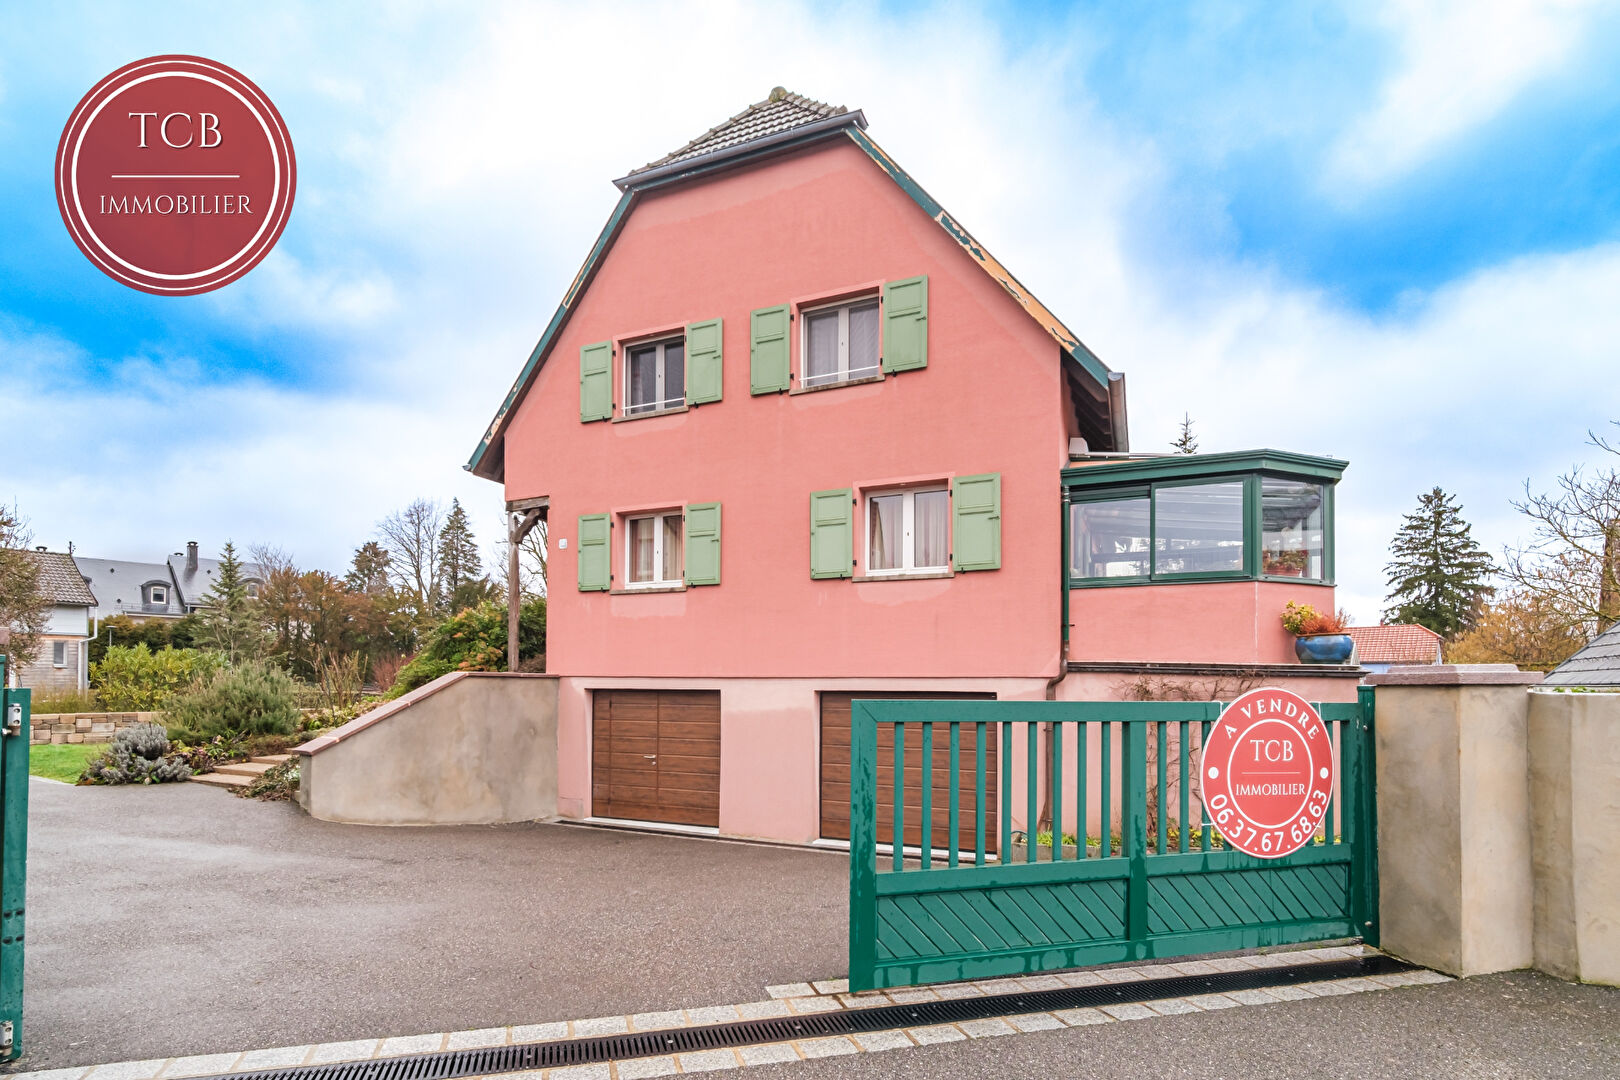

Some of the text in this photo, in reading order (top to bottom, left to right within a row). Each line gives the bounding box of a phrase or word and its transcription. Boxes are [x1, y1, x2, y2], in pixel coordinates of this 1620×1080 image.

[1224, 698, 1320, 740] A VENDRE
[1250, 739, 1294, 762] TCB
[1235, 783, 1306, 796] IMMOBILIER
[1210, 789, 1327, 852] 06.37.67.68.63
